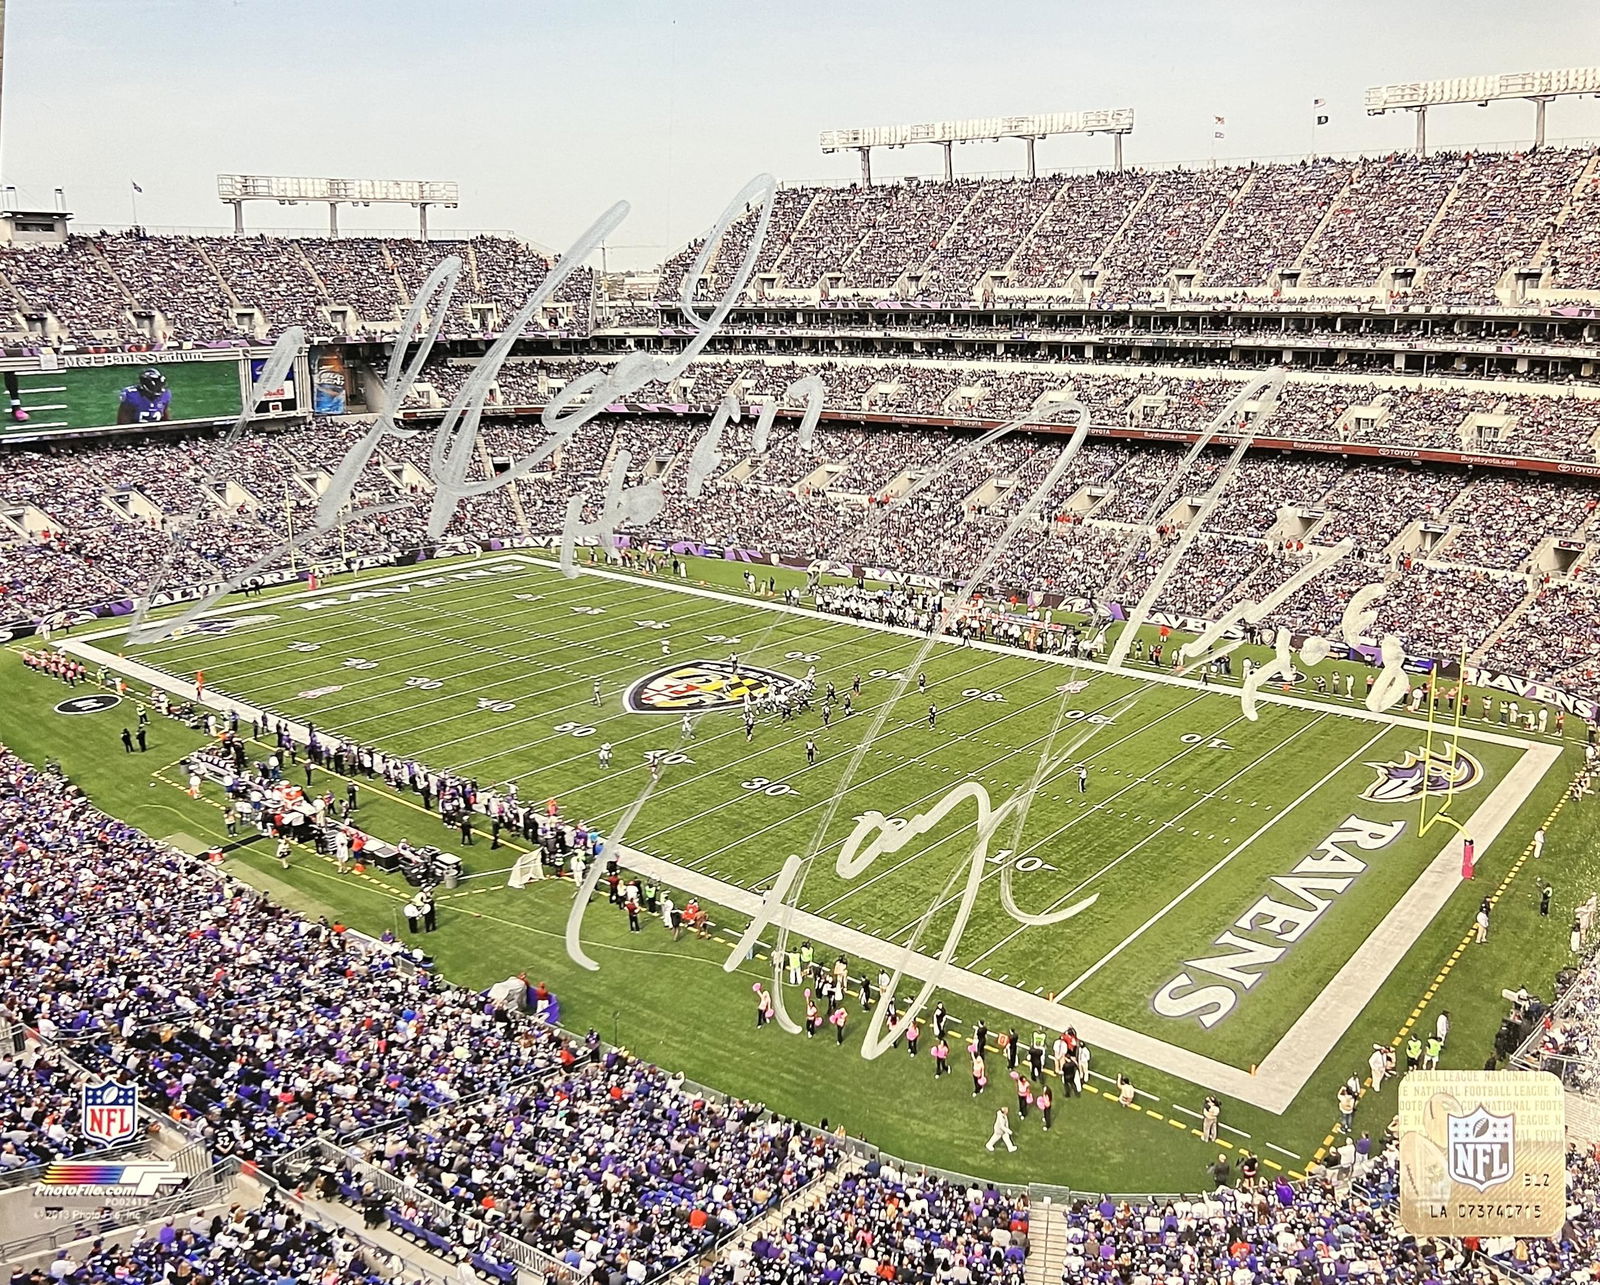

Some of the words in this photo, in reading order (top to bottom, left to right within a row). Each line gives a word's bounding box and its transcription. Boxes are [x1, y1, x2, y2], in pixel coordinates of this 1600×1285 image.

[64, 355, 99, 367] M&T
[104, 352, 143, 366] Bank
[148, 350, 204, 363] Stadium
[1389, 448, 1419, 458] TOYOTA
[1570, 465, 1600, 475] TOYOTA
[284, 563, 526, 611] RAVENS
[1466, 667, 1593, 718] RAVENS
[477, 697, 516, 713] 40
[553, 721, 597, 738] 50
[741, 777, 800, 796] 30
[986, 849, 1058, 872] 10
[1152, 813, 1407, 1030] RAVENS
[1443, 1072, 1480, 1082] LEAGUE
[1484, 1072, 1531, 1082] NATIONAL
[1464, 1085, 1511, 1097] FOOTBALL
[1514, 1085, 1550, 1097] LEAGUE
[1486, 1100, 1532, 1112] NATIONAL
[1454, 1143, 1508, 1182] NFL
[1430, 1204, 1448, 1218] LA
